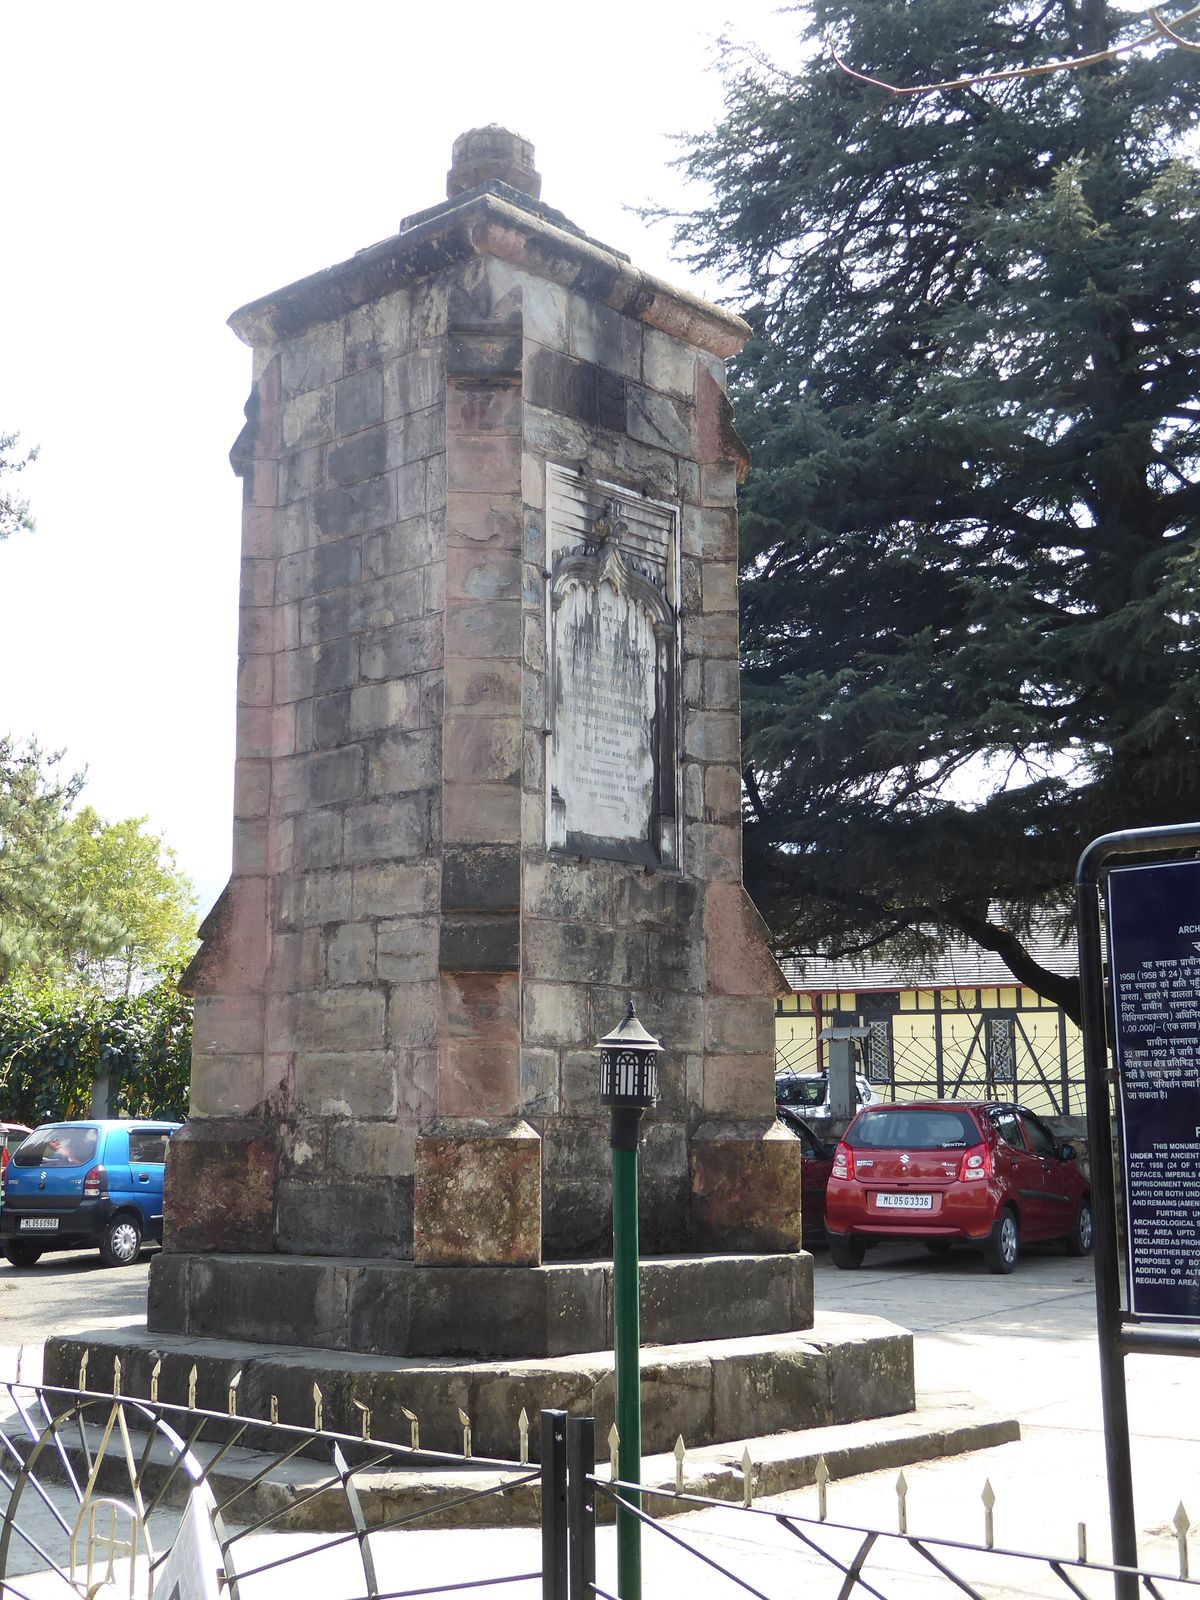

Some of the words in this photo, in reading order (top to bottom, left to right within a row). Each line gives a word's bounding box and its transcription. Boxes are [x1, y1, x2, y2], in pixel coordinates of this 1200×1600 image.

[1142, 961, 1152, 969] यह
[1159, 969, 1166, 978] के
[1184, 967, 1191, 976] के
[1159, 979, 1169, 988] को
[1173, 978, 1186, 987] क्षति
[1144, 990, 1160, 999] खतरे
[1170, 990, 1192, 998] डालता
[1121, 1002, 1135, 1012] लिए
[1141, 1001, 1162, 1010] प्राचीन
[1146, 1036, 1167, 1046] प्राचीन
[1135, 1050, 1148, 1058] तथा
[1177, 1046, 1193, 1055] जारी
[1125, 1059, 1141, 1068] भीतर
[1143, 1060, 1152, 1068] का
[1154, 1058, 1165, 1067] क्षेत्र
[1139, 1069, 1145, 1079] है
[1147, 1070, 1161, 1078] तथा
[1163, 1068, 1181, 1079] इसके
[1184, 1068, 1198, 1077] आगे
[1153, 1078, 1180, 1088] परिवर्तन
[1181, 1080, 1195, 1088] तथा
